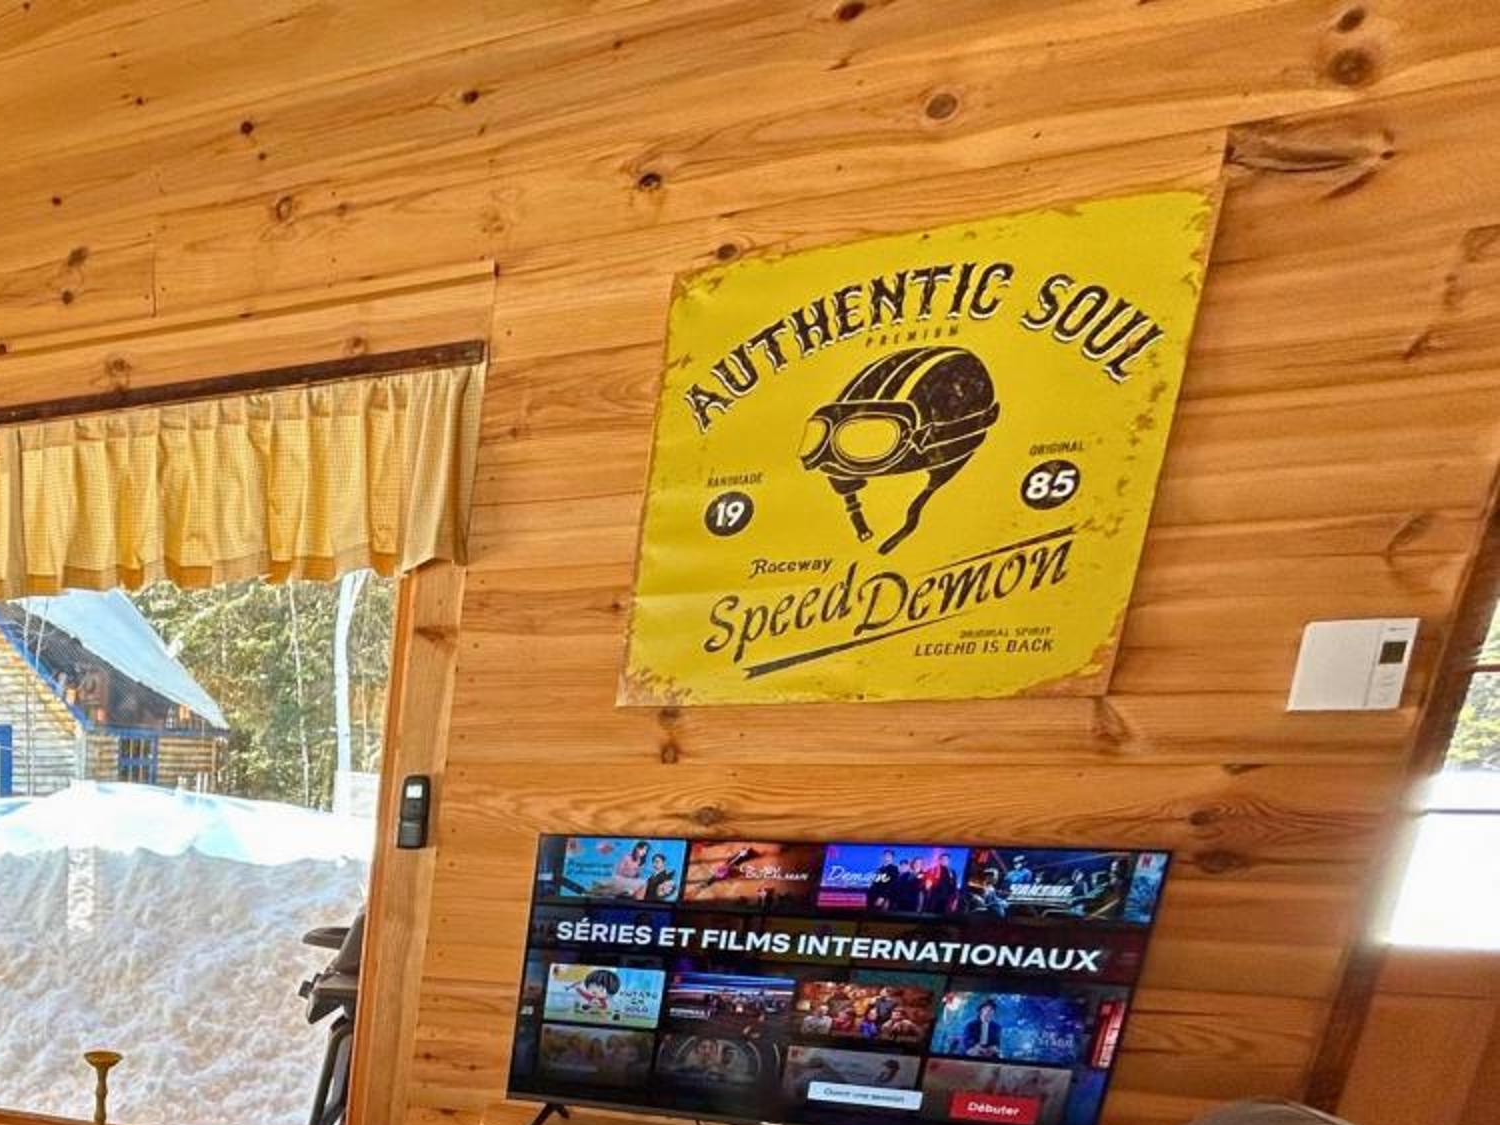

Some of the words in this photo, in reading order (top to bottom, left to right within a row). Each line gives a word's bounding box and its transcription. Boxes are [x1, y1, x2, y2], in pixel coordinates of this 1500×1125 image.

[684, 262, 1014, 433] AUTHENTIC
[1020, 273, 1164, 385] SOUL
[865, 325, 959, 348] PREMIUM
[1026, 469, 1077, 500] 85
[715, 501, 745, 527] 19
[748, 557, 833, 579] Raceway
[703, 560, 858, 663] Speed
[853, 540, 1072, 636] Demon
[914, 641, 977, 657] LEGEND
[983, 639, 999, 654] IS
[1006, 638, 1054, 654] BACK
[556, 917, 651, 945] SÉRIES
[658, 927, 696, 948] ET
[701, 929, 789, 954] FILMS
[797, 933, 1101, 972] INTERNATIONAUX
[967, 1100, 1021, 1117] Débuter
